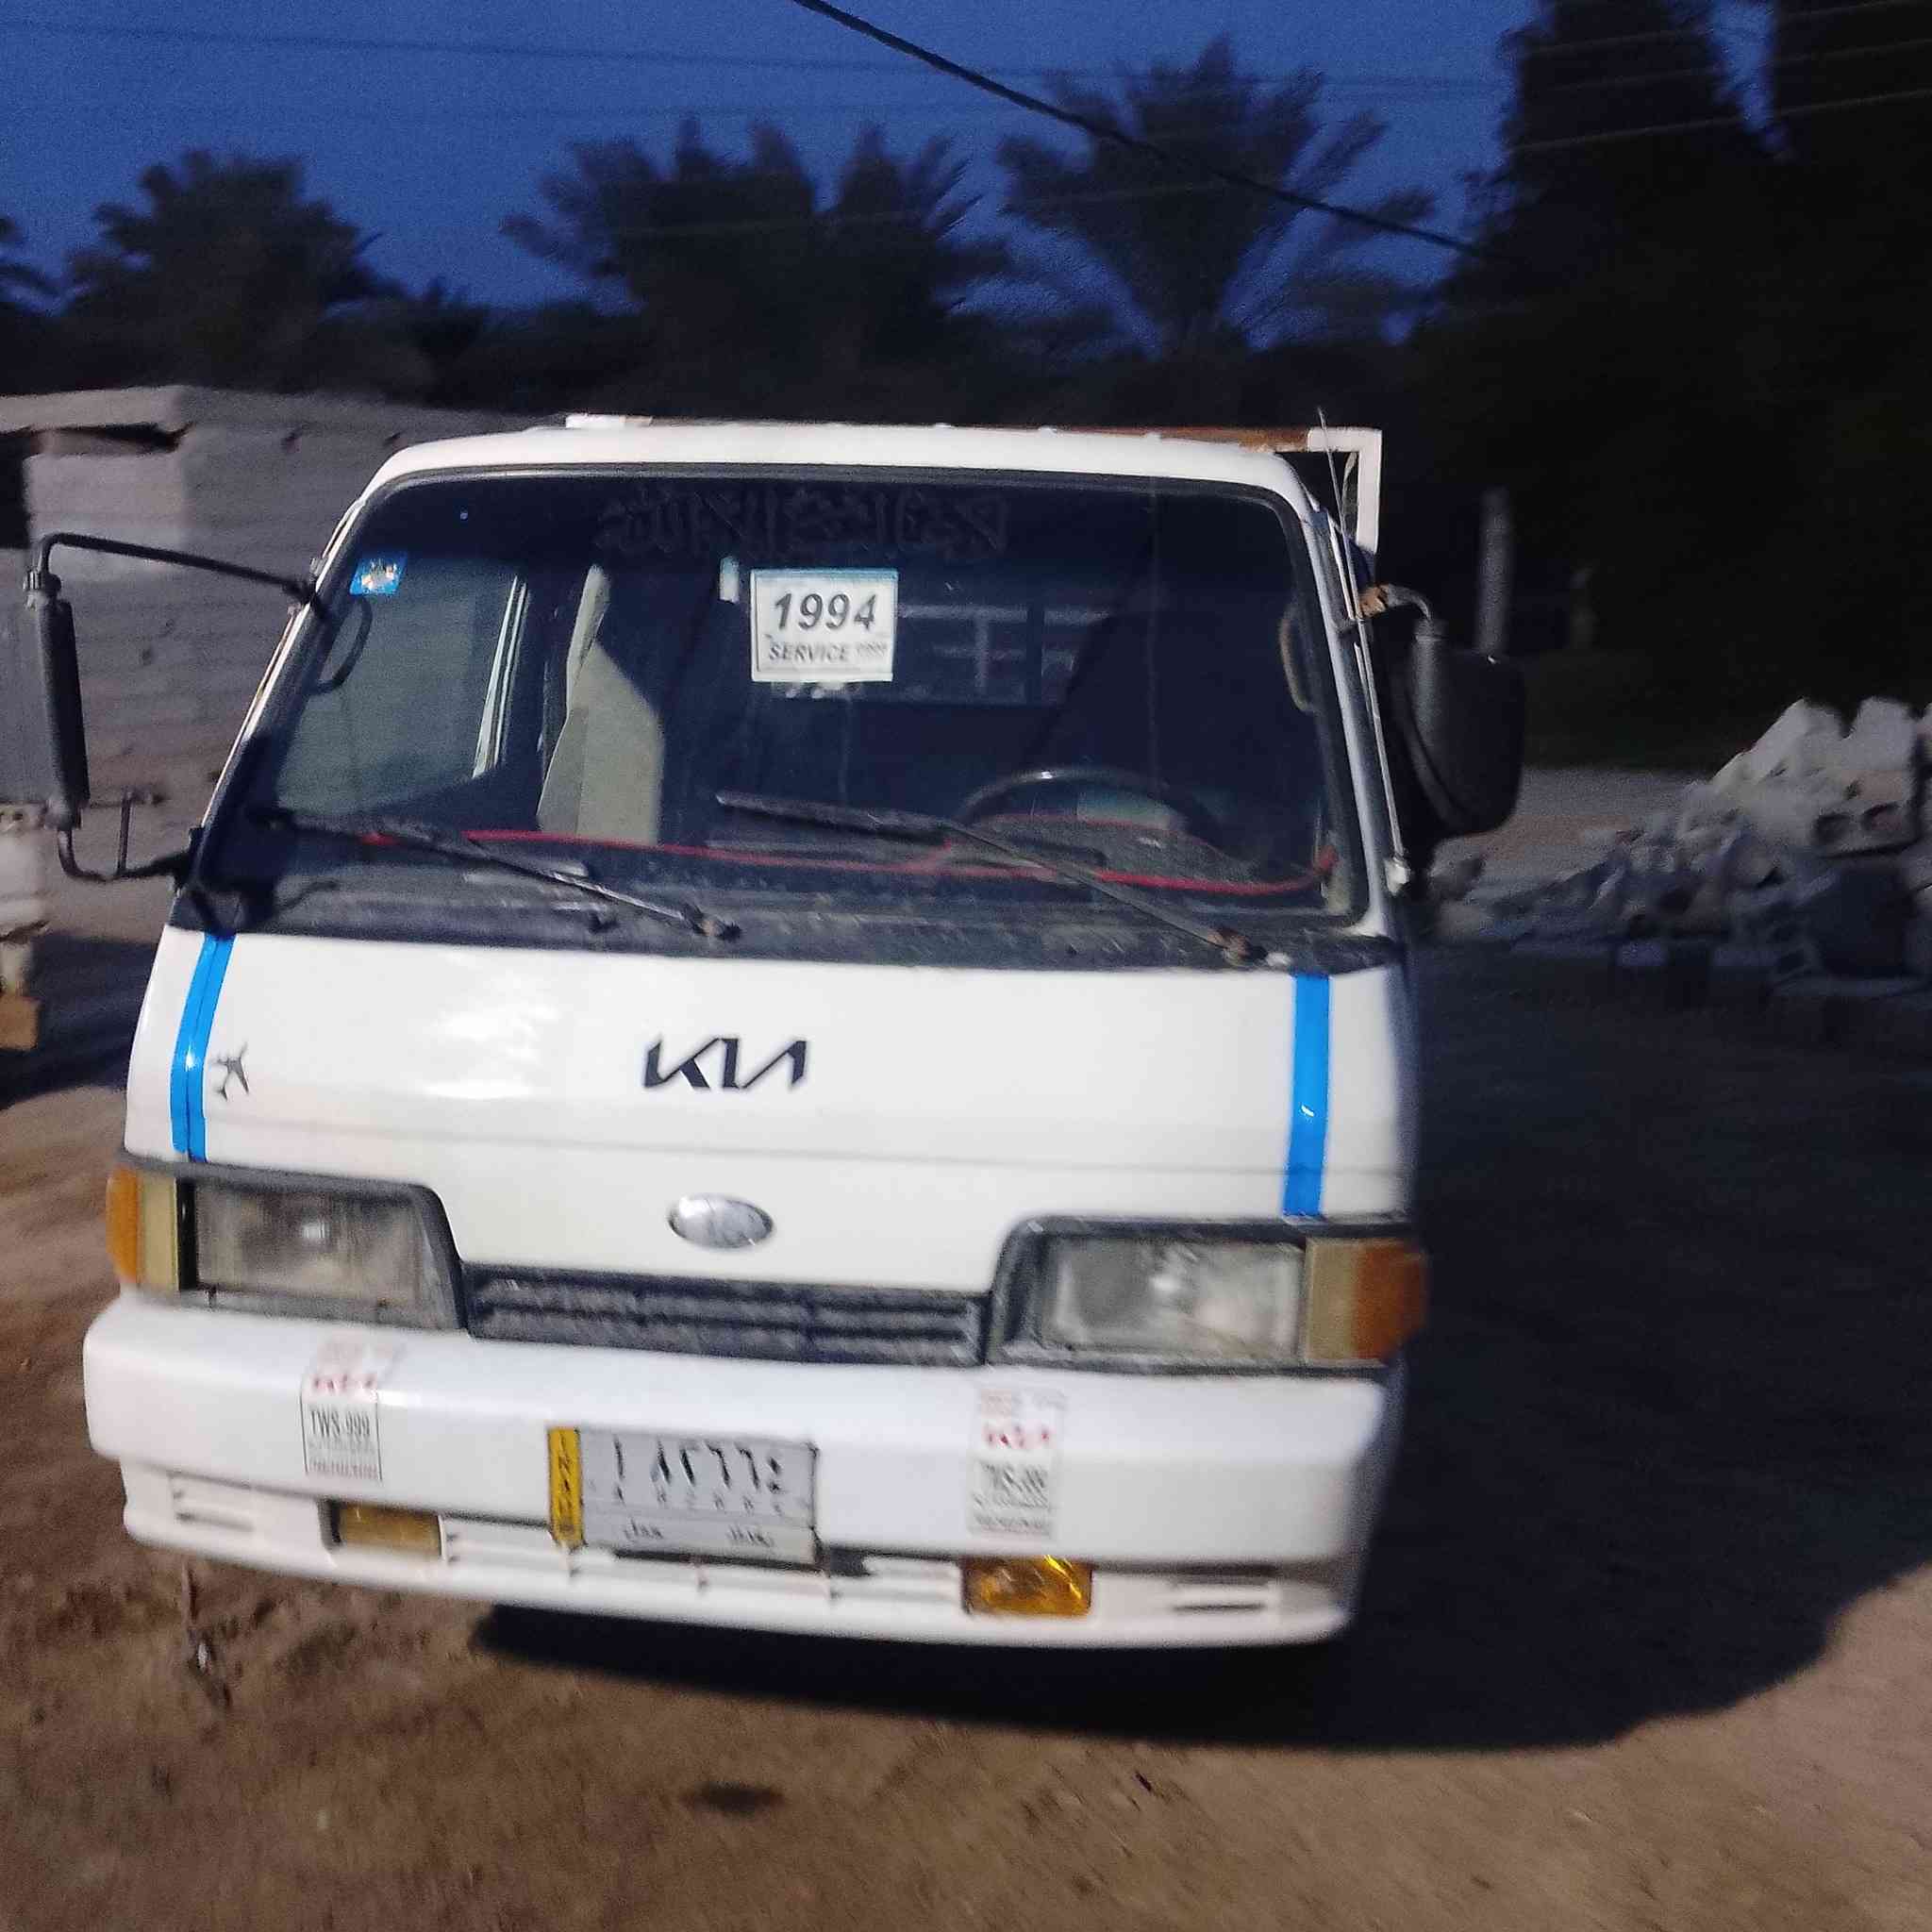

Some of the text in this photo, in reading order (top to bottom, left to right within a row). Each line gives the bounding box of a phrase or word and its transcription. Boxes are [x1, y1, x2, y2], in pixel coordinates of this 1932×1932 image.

[774, 592, 877, 631] 1994
[768, 641, 849, 663] SERVICE
[643, 1035, 808, 1090] KIA
